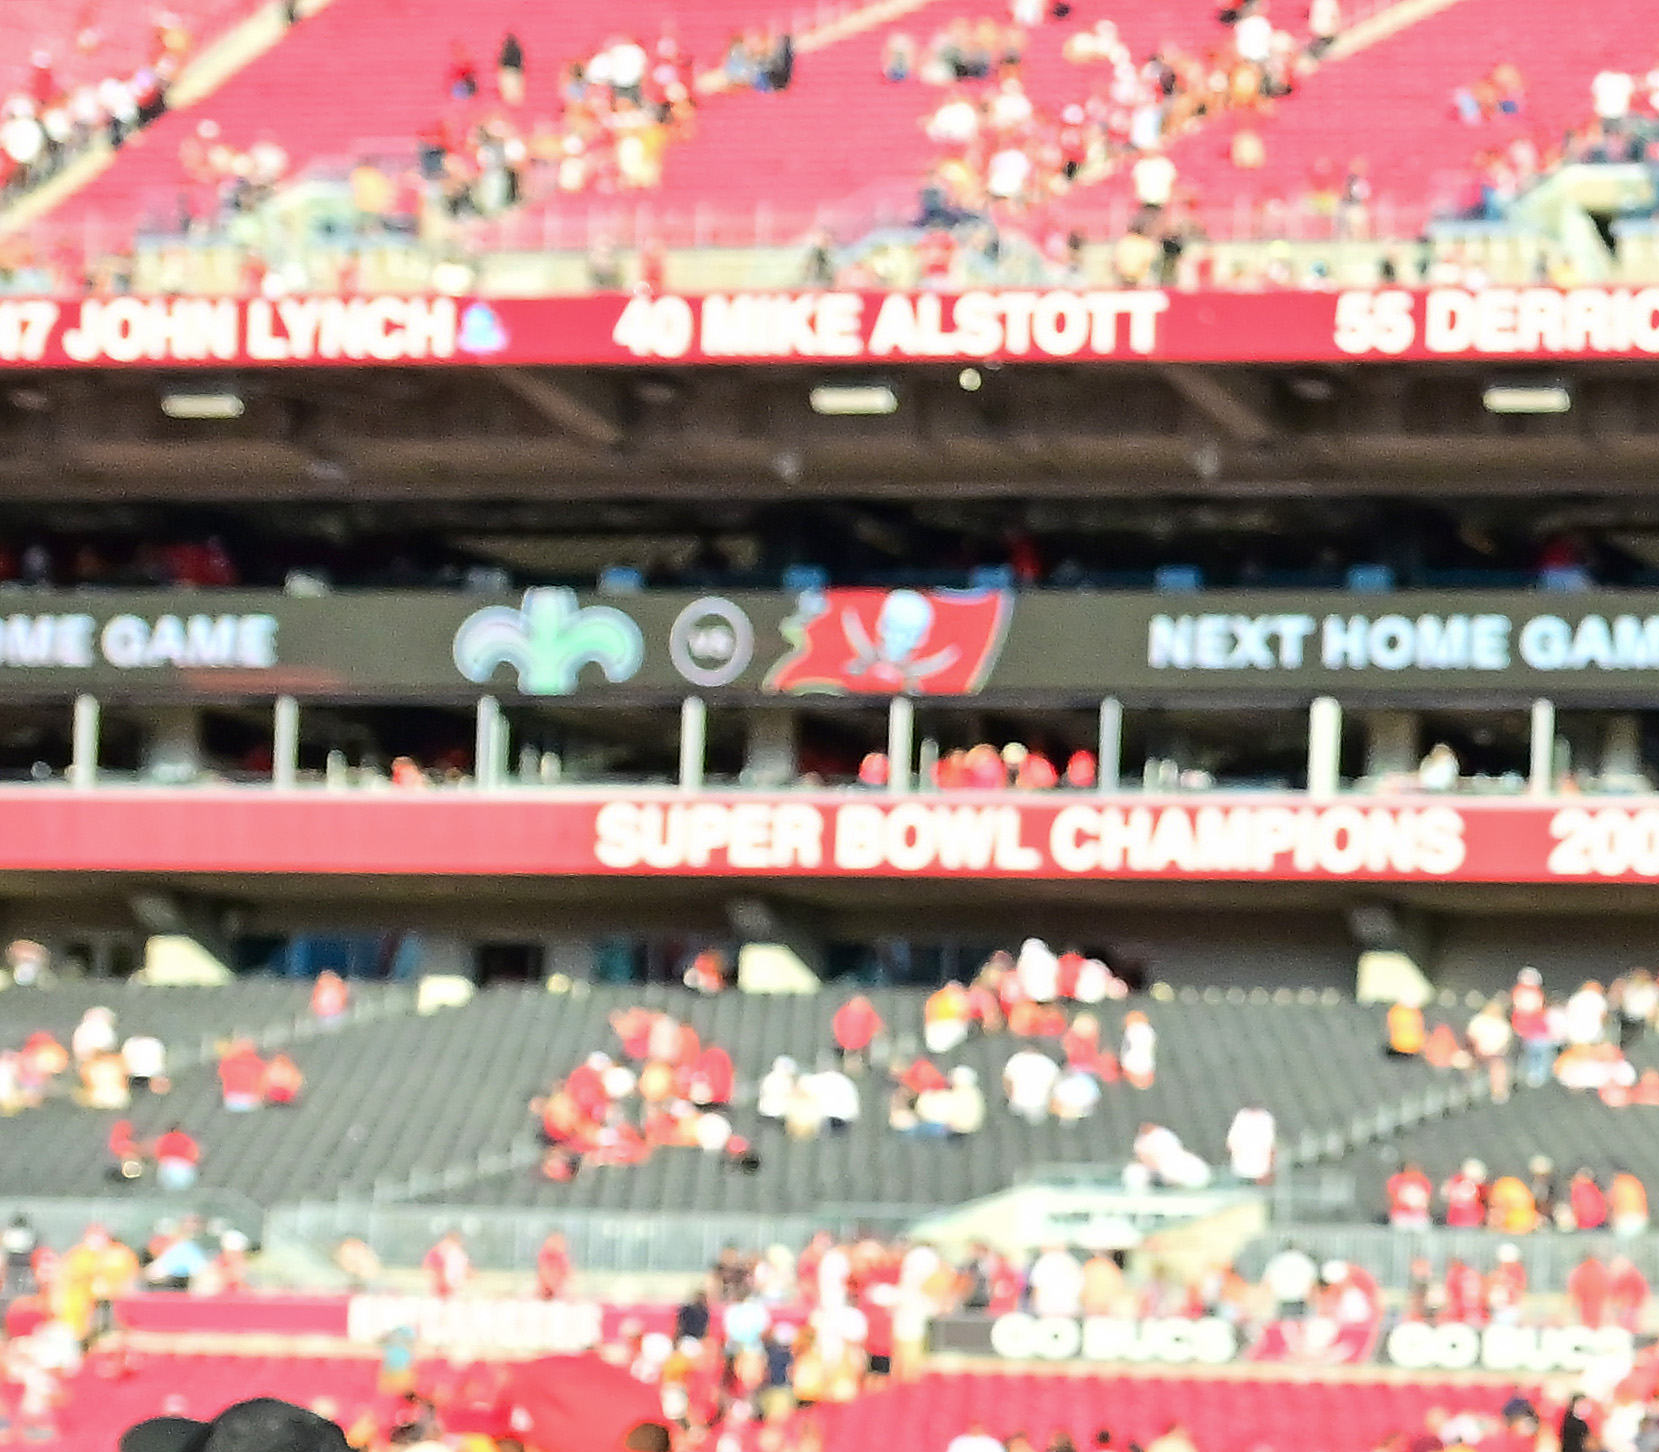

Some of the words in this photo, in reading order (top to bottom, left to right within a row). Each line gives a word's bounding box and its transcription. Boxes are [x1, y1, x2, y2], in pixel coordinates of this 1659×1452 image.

[63, 297, 238, 361] JOHN
[247, 296, 456, 360] LYNCH
[701, 294, 863, 357] MIKE
[868, 289, 1170, 357] ALSTOTT
[0, 613, 95, 668] ME
[101, 613, 279, 668] GAME
[1148, 615, 1311, 670] NEXT
[1320, 615, 1510, 670] HOME
[596, 805, 822, 869] SUPER
[835, 805, 1040, 869] BOWL
[1050, 805, 1464, 873] CHAMPIONS
